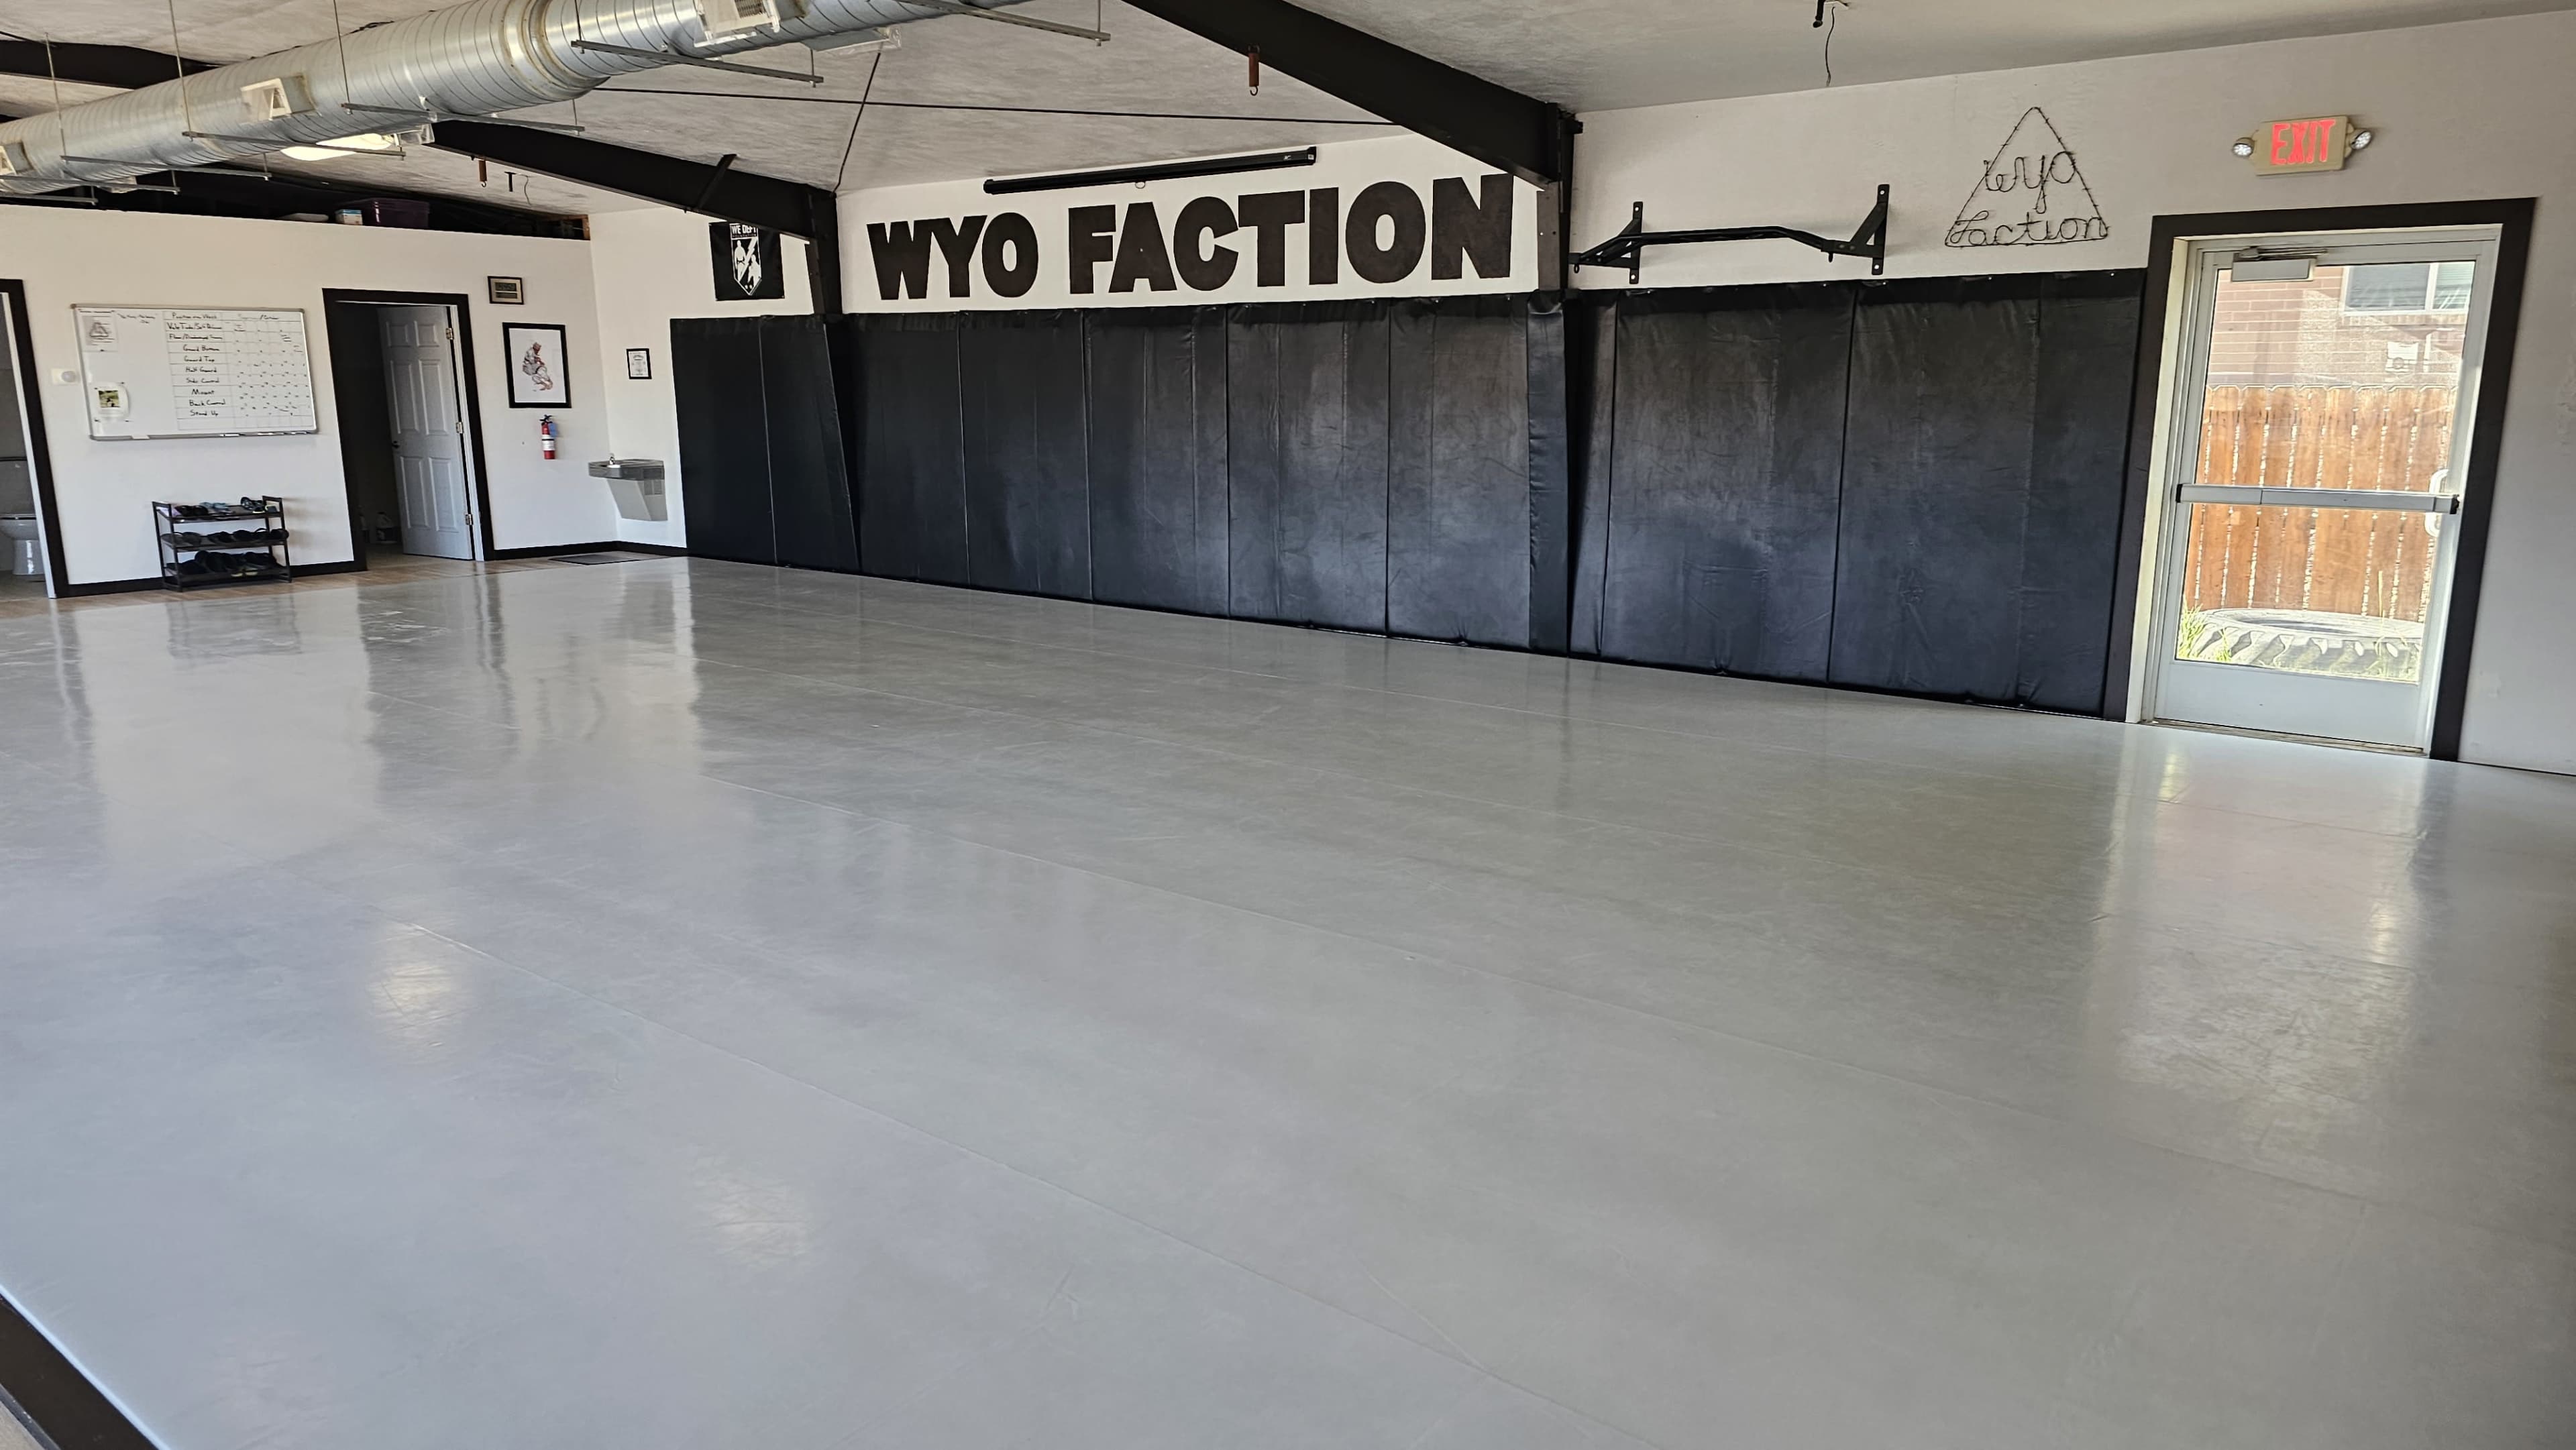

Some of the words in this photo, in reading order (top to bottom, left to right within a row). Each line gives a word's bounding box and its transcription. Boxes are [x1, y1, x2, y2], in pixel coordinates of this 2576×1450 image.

[2270, 118, 2336, 166] EXIT
[732, 225, 741, 234] WE
[866, 212, 1039, 300] WYO
[1068, 172, 1514, 295] FACTION
